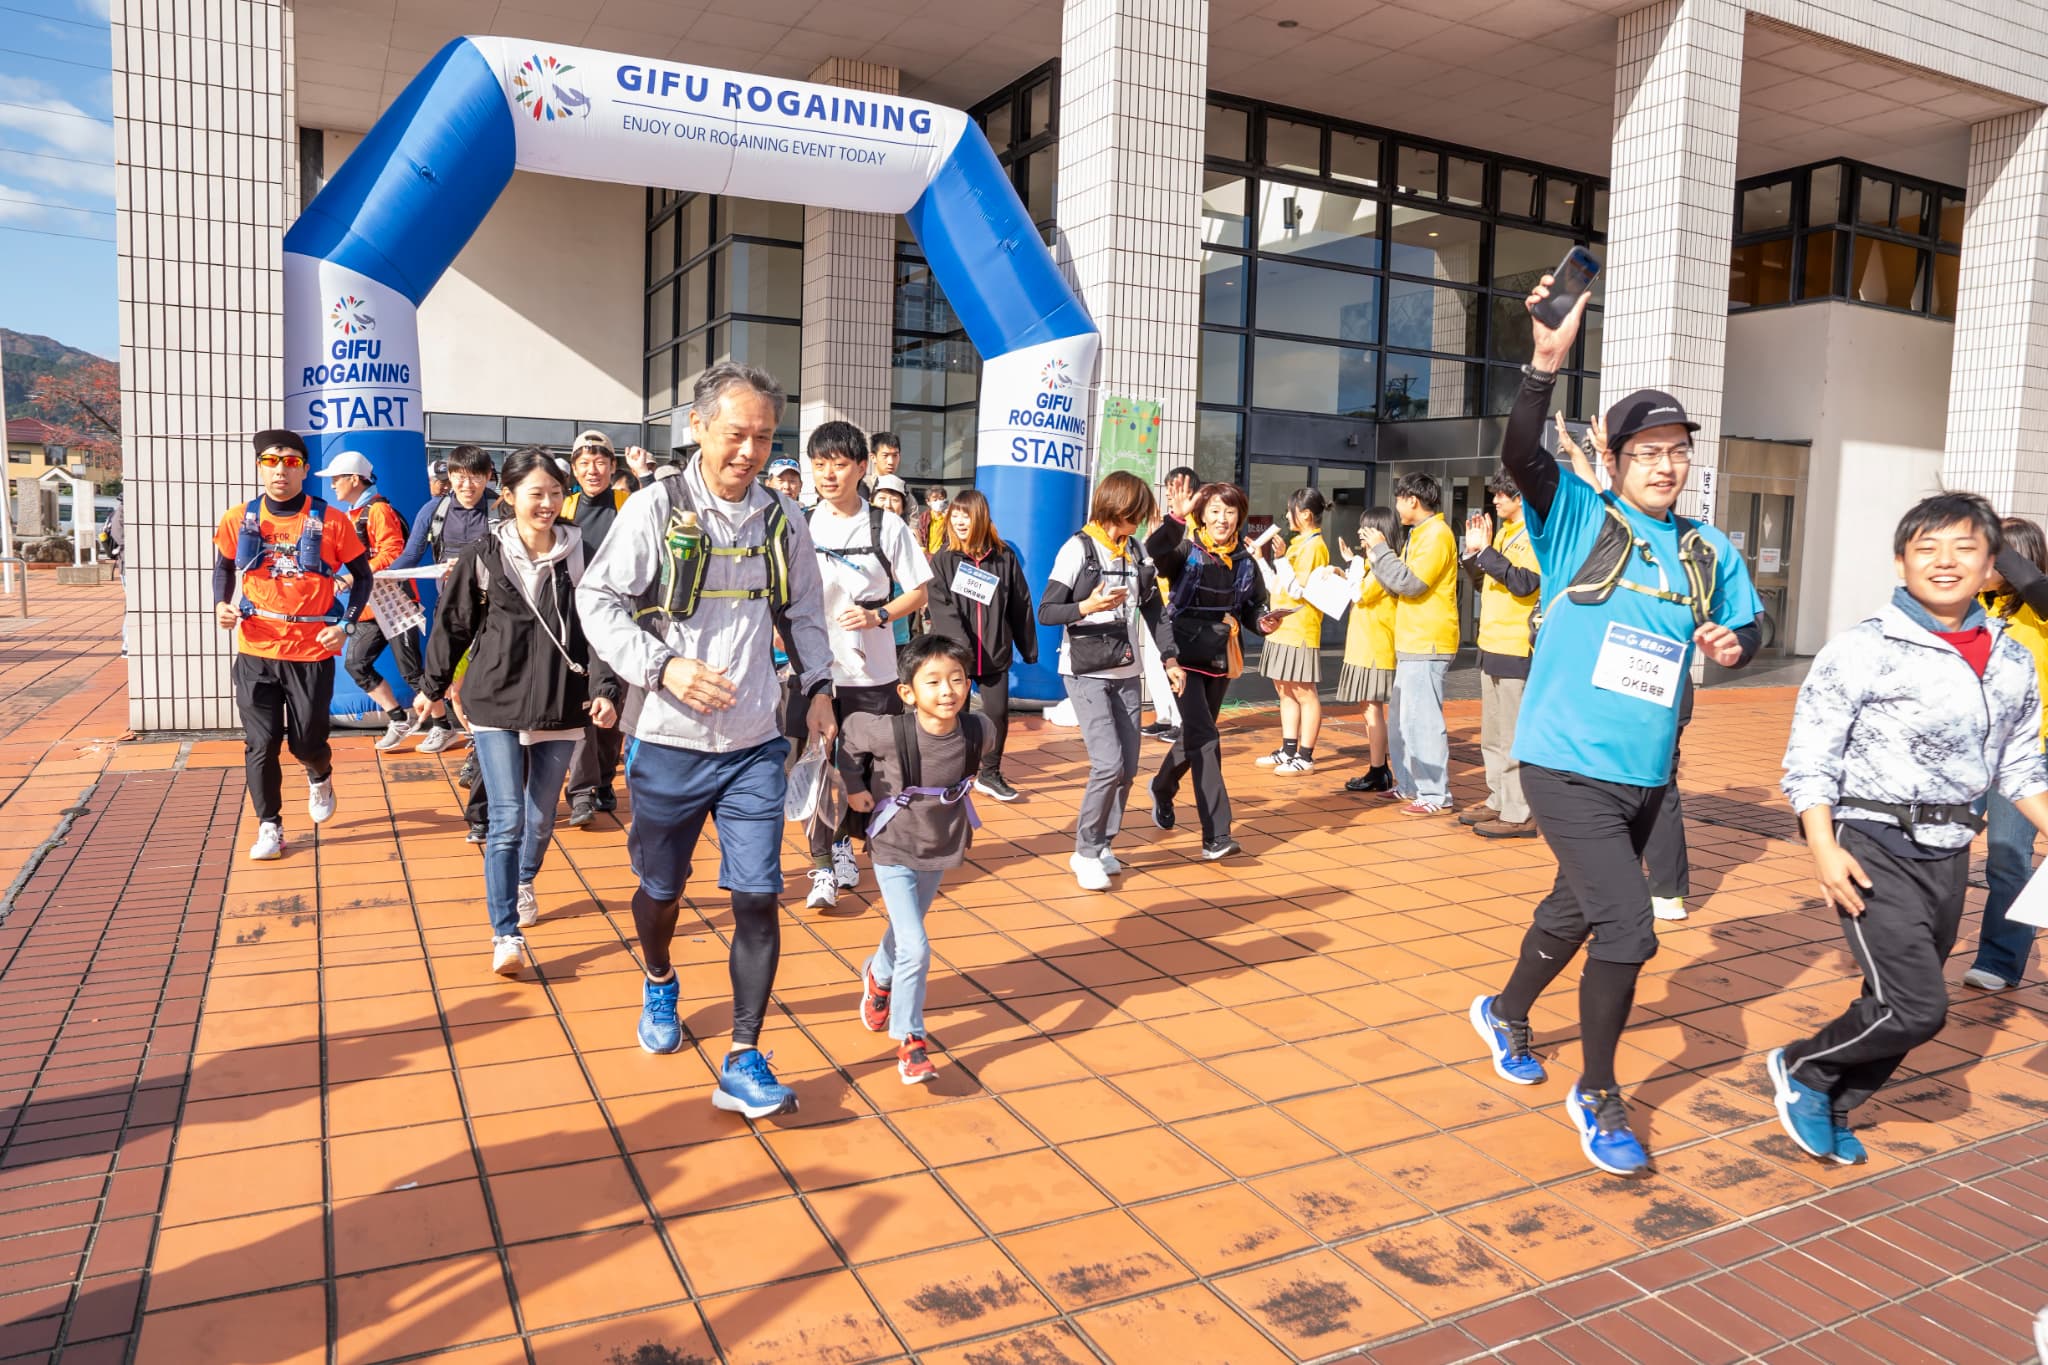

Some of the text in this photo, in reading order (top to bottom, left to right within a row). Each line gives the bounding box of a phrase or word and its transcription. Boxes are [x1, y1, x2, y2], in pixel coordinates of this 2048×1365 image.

[616, 64, 932, 135] GIFU ROGAINING
[623, 115, 886, 166] ENJOY OUR ROGAINING EVENT TODAY
[331, 339, 382, 360] GIFU
[302, 362, 410, 388] ROGAINING
[308, 396, 409, 431] START
[1036, 392, 1073, 413] GIFU
[1008, 408, 1087, 436] ROGAINING
[1011, 436, 1084, 471] START
